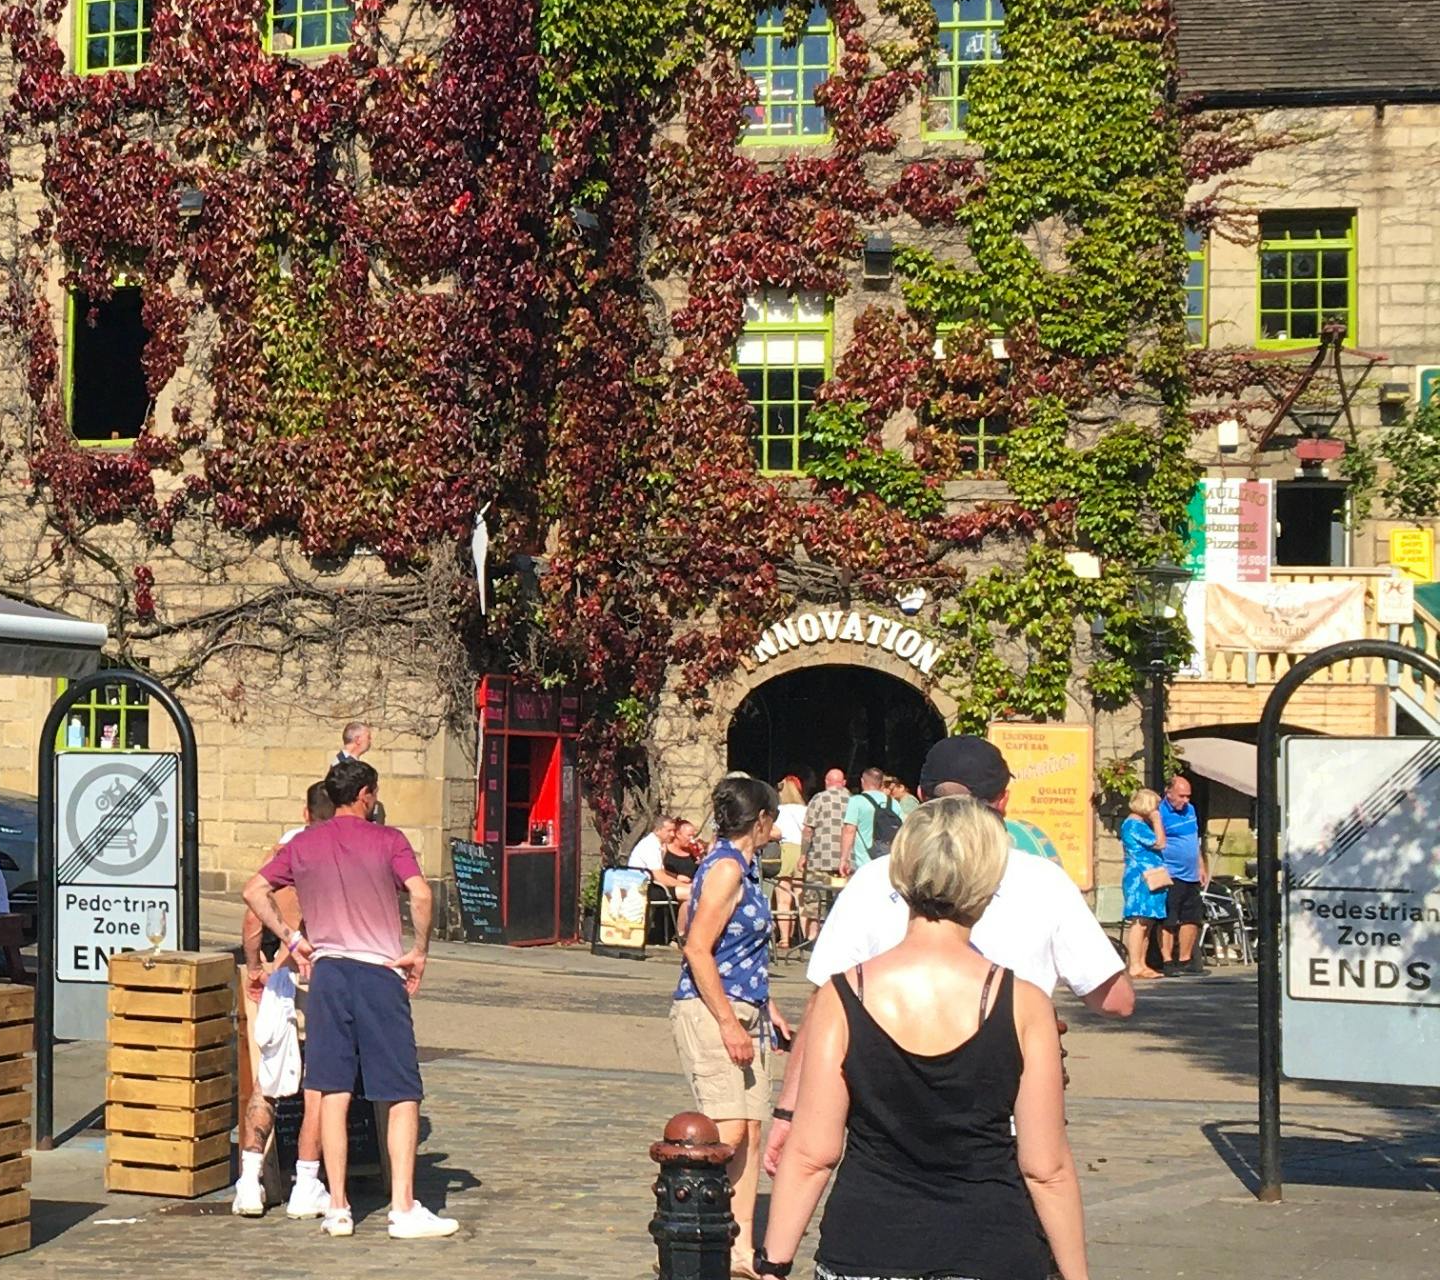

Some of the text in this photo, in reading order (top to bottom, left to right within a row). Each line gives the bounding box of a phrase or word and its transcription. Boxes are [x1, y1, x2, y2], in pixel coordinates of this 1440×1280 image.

[753, 611, 944, 674] NNOVATION
[1038, 787, 1077, 796] QUALITY
[1300, 898, 1440, 922] Pedestrian
[93, 917, 140, 935] Zone
[1338, 925, 1402, 947] Zone
[1309, 958, 1432, 991] ENDS
